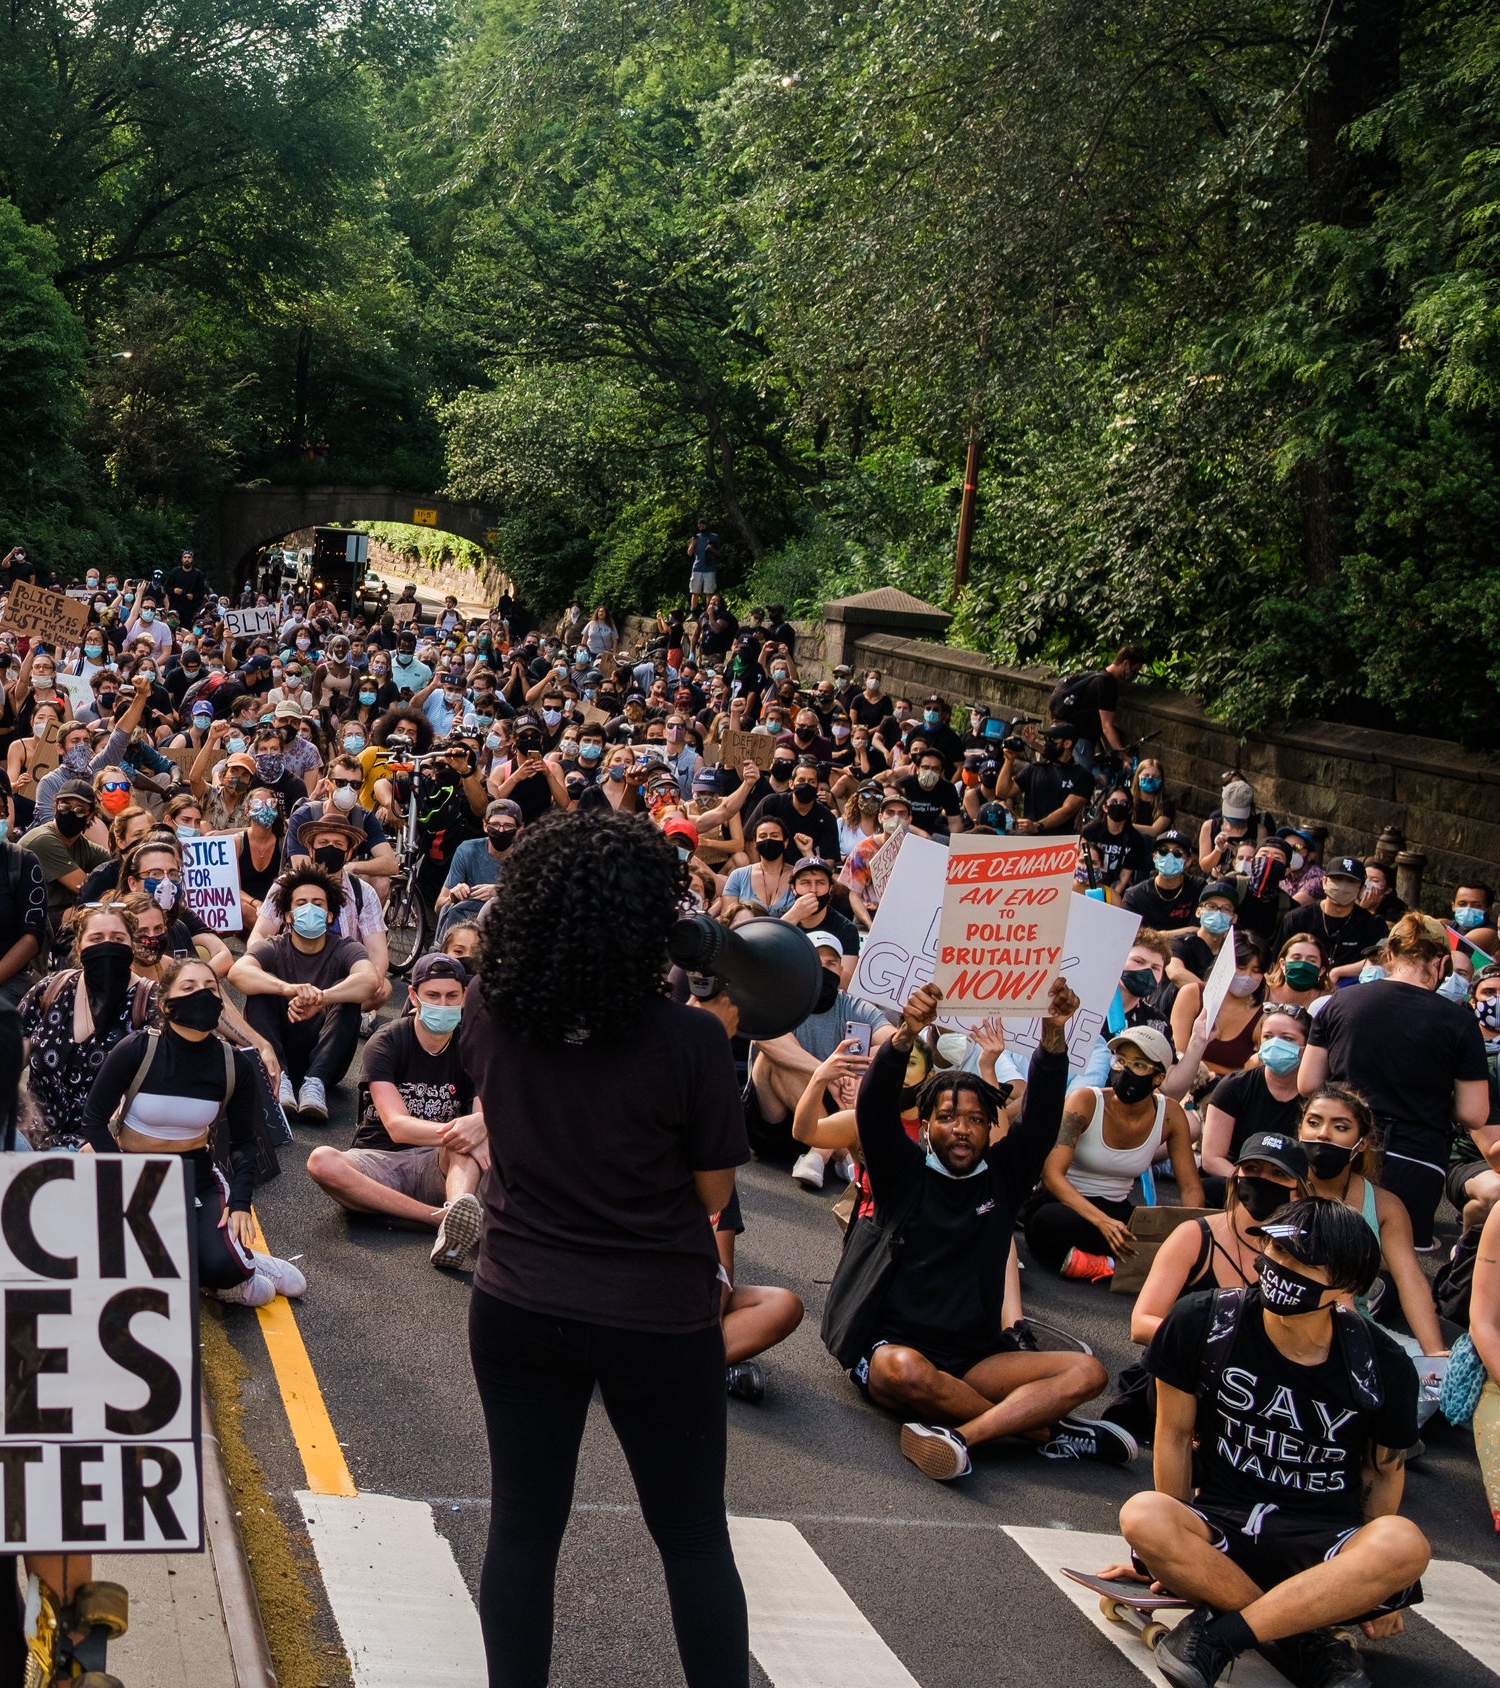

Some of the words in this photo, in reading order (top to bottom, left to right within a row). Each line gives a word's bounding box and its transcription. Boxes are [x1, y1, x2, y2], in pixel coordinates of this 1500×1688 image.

[15, 585, 64, 614] POLICE
[4, 607, 42, 629] JUST
[43, 620, 57, 631] THE
[13, 599, 65, 624] BRUTALITY
[65, 617, 79, 627] IS
[226, 611, 270, 634] BLM
[740, 746, 754, 757] THE
[182, 841, 229, 867] STICE
[948, 858, 985, 880] WE
[988, 849, 1076, 877] DEMAND
[188, 869, 212, 887] FOR
[182, 887, 236, 908] EONNA
[959, 887, 1003, 904] AN
[1004, 887, 1059, 906] END
[998, 909, 1015, 919] TO
[966, 923, 1038, 942] POLICE
[941, 946, 1061, 966] BRUTALITY
[946, 969, 1048, 1000] NOW!
[1263, 1265, 1267, 1275] I
[1267, 1269, 1307, 1297] CAN'T
[1217, 1367, 1358, 1442] SAY
[1217, 1408, 1347, 1464] THEIR
[1217, 1436, 1346, 1493] NAMES
